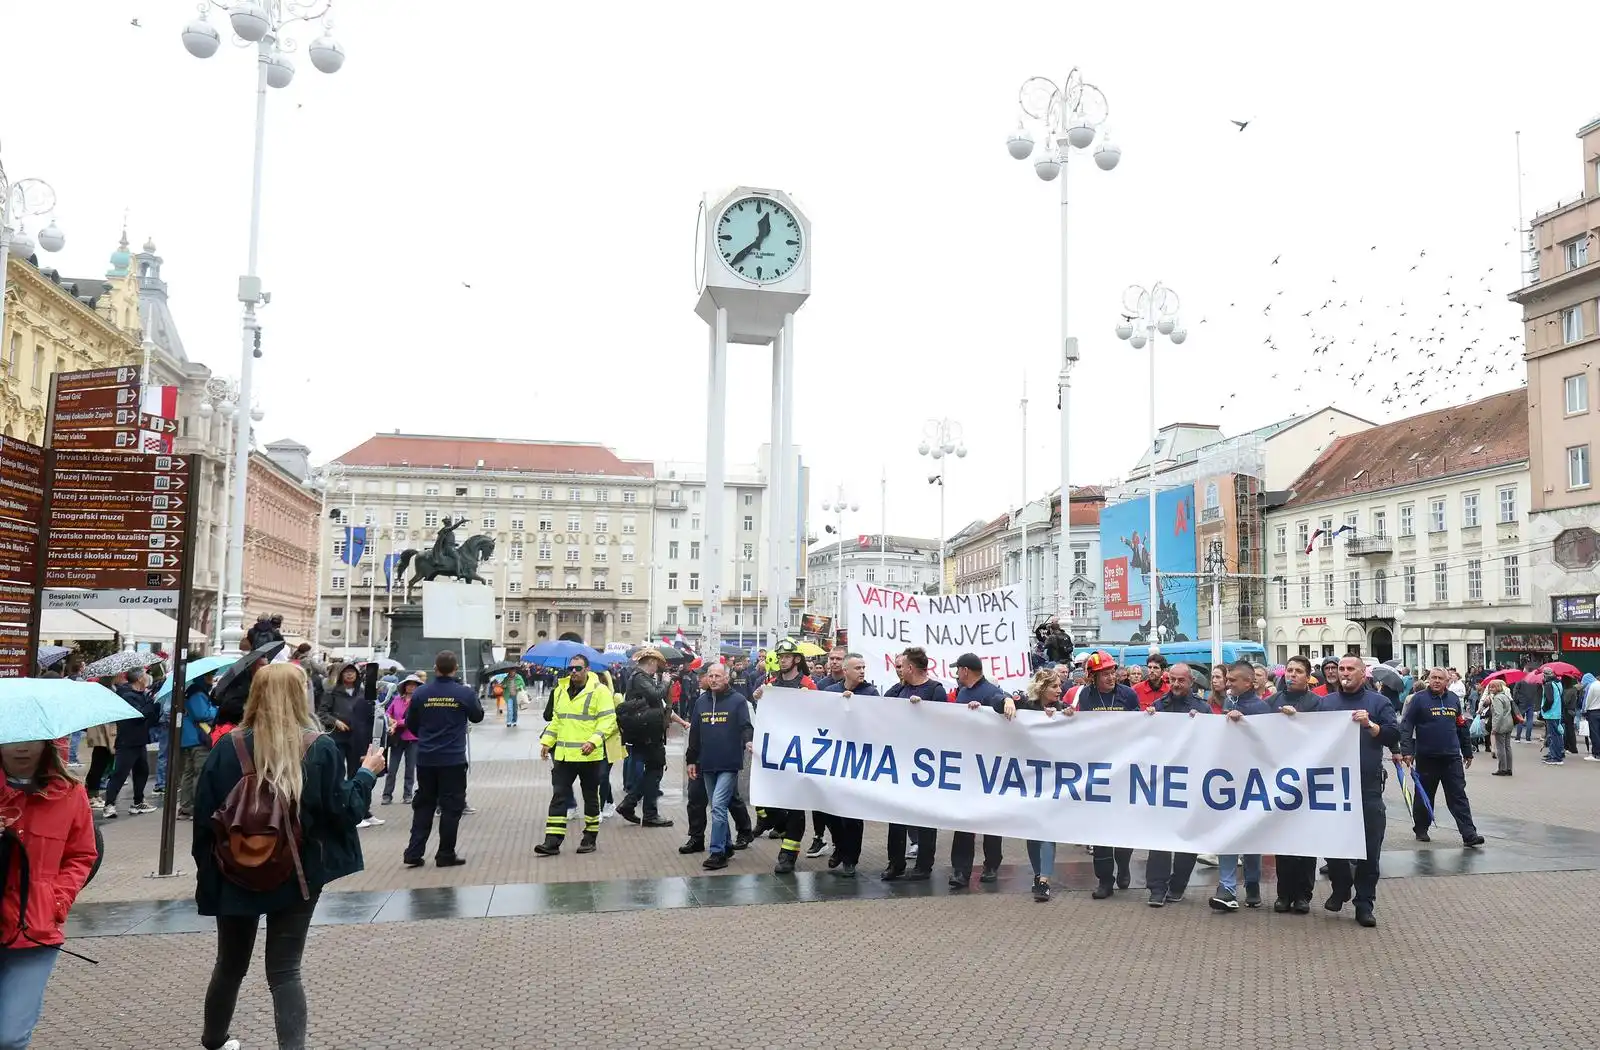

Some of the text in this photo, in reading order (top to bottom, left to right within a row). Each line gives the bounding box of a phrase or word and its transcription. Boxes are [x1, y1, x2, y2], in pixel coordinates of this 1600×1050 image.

[95, 411, 113, 420] Zagreb
[56, 473, 113, 482] Muzej Mimara
[54, 493, 77, 501] Muzej
[52, 512, 124, 522] Etnografski muzej
[50, 532, 83, 540] Hrvatsko
[114, 553, 138, 561] muzej
[142, 596, 173, 604] Zagreb
[856, 584, 1018, 615] VATRA NAM IPAK
[862, 613, 1016, 646] NIJE NAJVEĆI
[762, 728, 1352, 812] LAŽIMA SE VATRE NE GASE!
